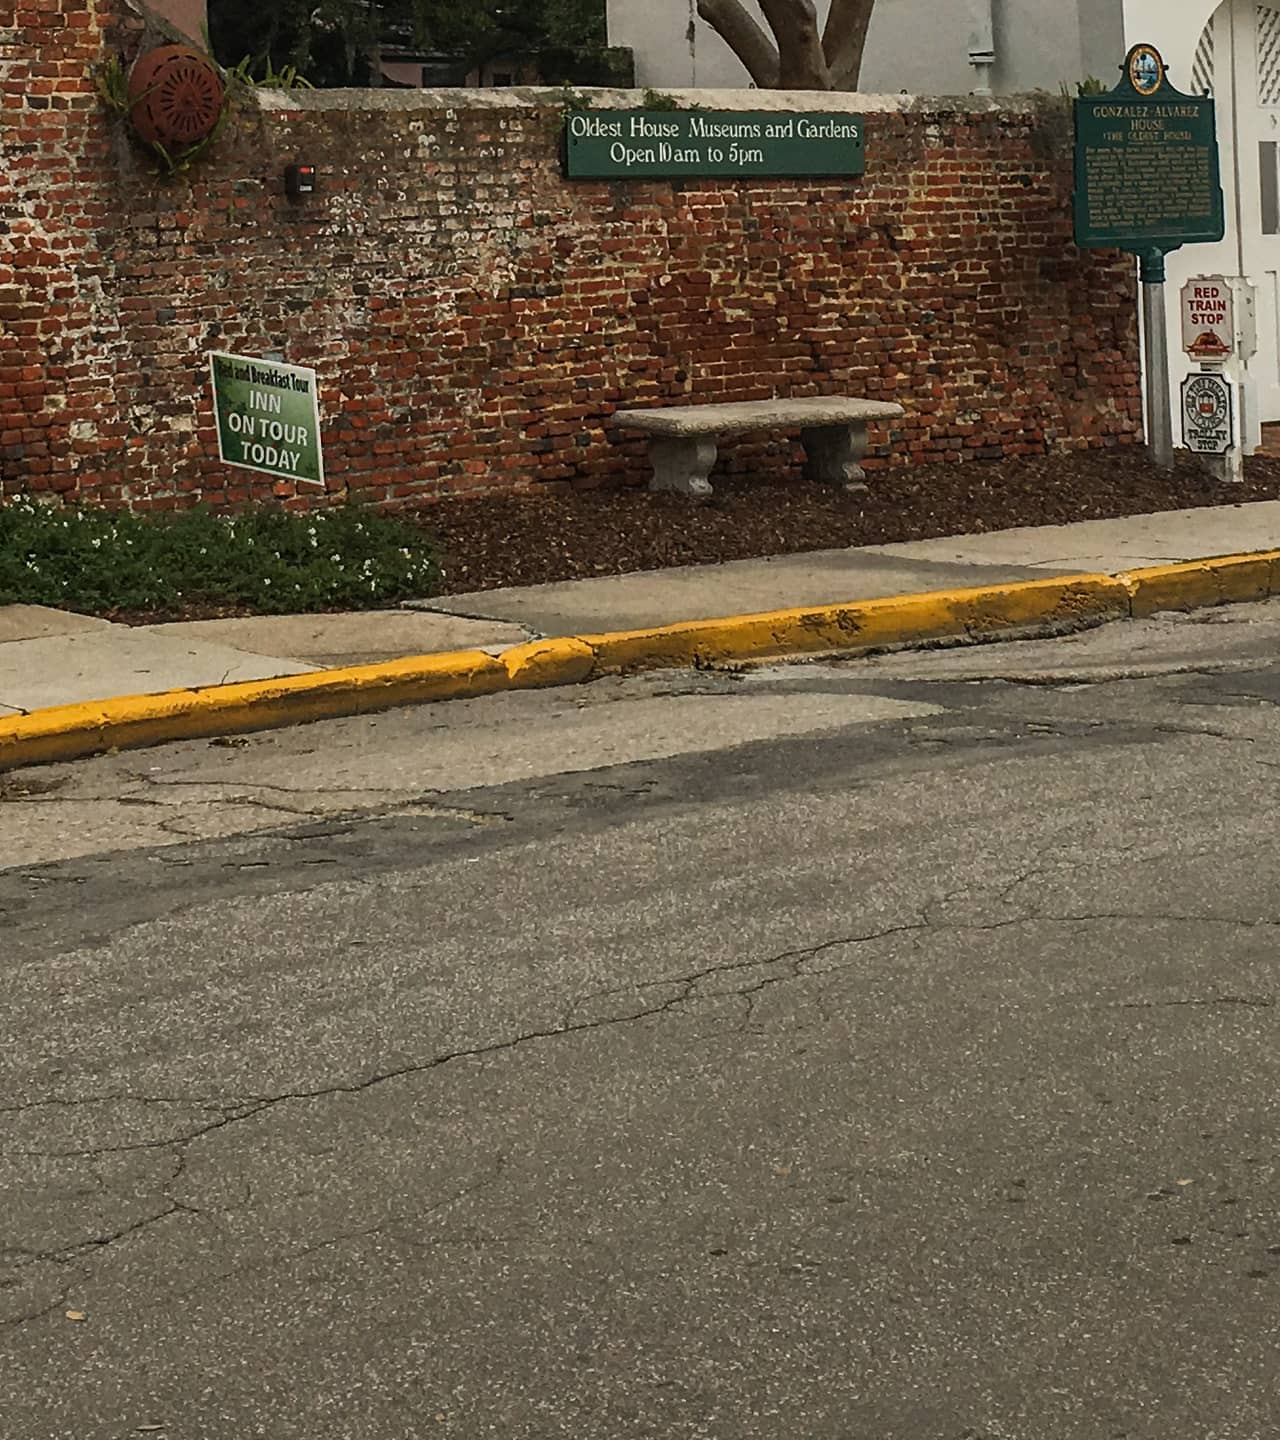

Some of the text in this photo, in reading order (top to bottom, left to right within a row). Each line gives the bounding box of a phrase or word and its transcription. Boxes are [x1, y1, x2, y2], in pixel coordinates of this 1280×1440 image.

[571, 116, 859, 138] Oldest House Museums and Gardens
[1130, 119, 1165, 131] HOUSE
[610, 142, 656, 166] Open
[707, 146, 724, 162] to
[728, 142, 764, 166] 5pm
[1193, 287, 1219, 298] RED
[1187, 300, 1226, 311] TRAIN
[1191, 313, 1224, 325] STOP
[234, 365, 250, 382] and
[251, 365, 291, 390] Breakfast
[290, 373, 309, 393] Tour
[249, 389, 281, 414] INN
[228, 412, 308, 446] ON TOUR
[240, 440, 301, 471] TODAY
[1197, 439, 1218, 450] STOP
